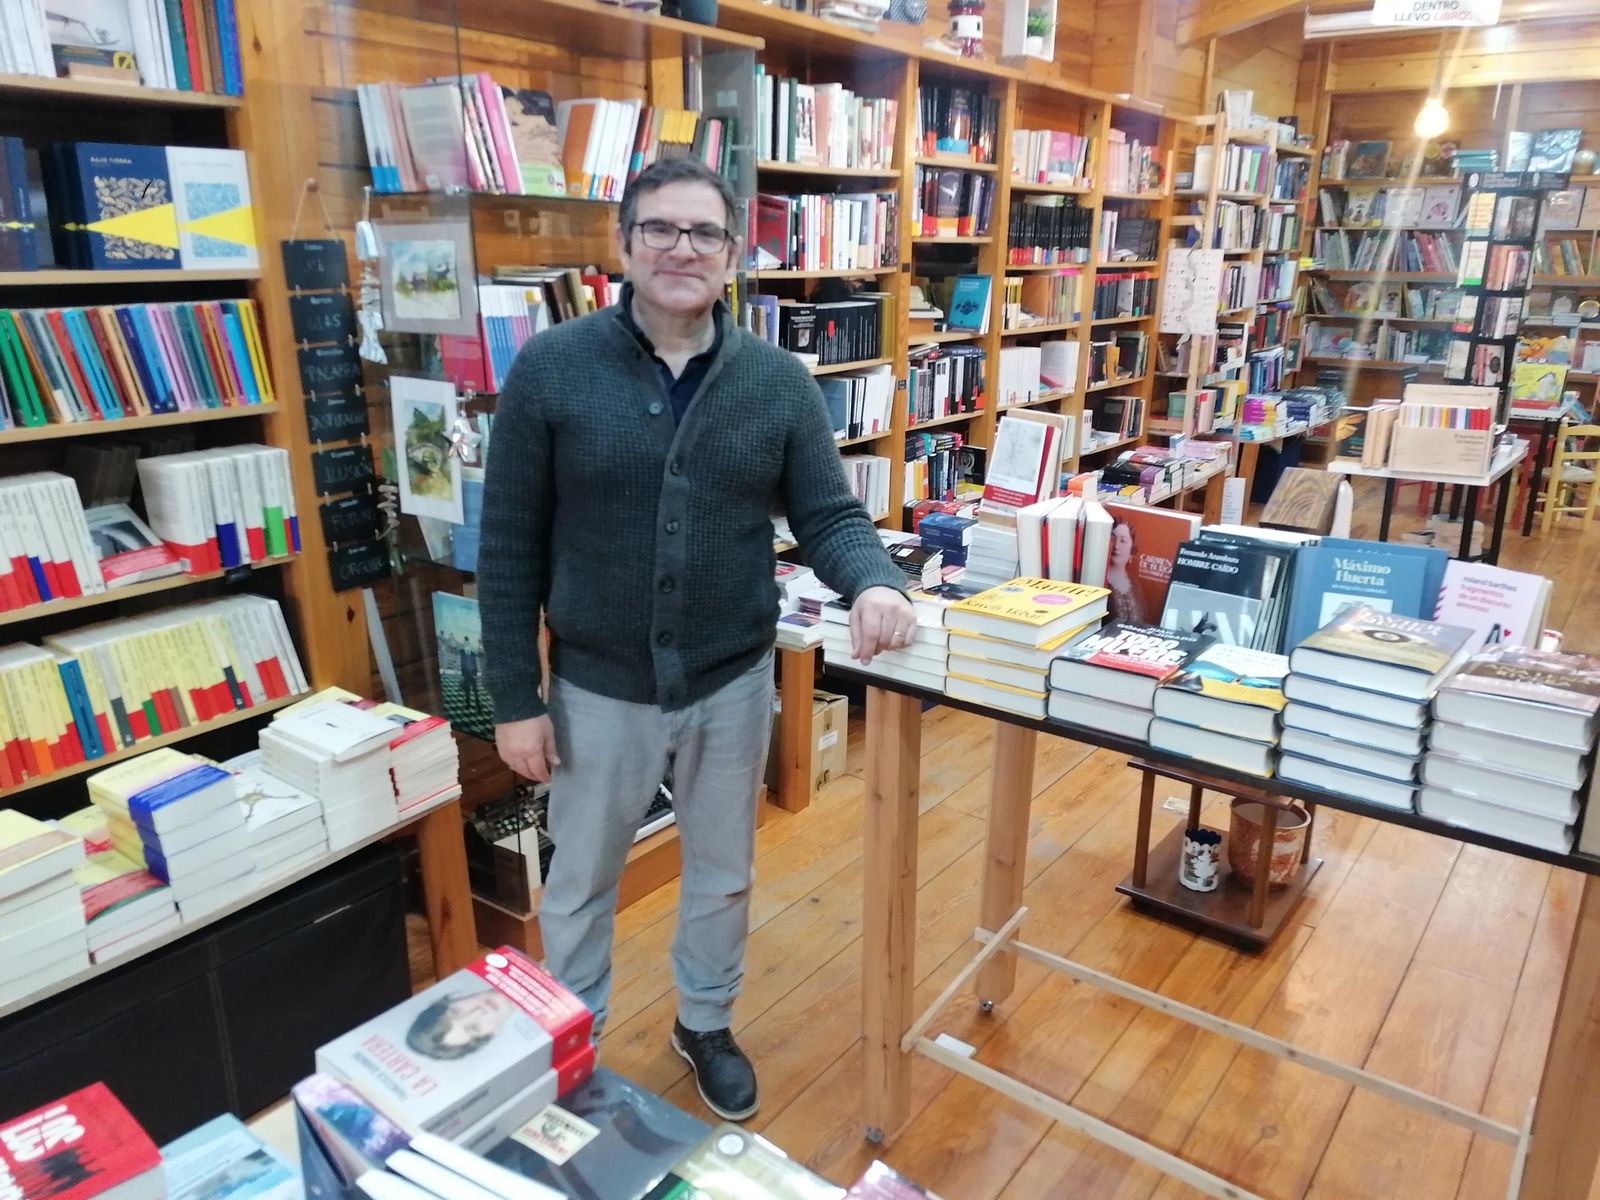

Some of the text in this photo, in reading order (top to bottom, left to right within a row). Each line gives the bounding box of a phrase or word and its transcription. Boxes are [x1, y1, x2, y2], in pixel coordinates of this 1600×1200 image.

[1413, 1, 1459, 11] DENTRO
[1394, 12, 1431, 21] LLEVO
[1180, 547, 1208, 558] Fernando
[1177, 557, 1211, 570] HOMBRE
[1331, 557, 1392, 574] Máximo
[1335, 569, 1386, 586] Huerta
[1488, 578, 1517, 592] barthes
[1119, 629, 1180, 651] TODO
